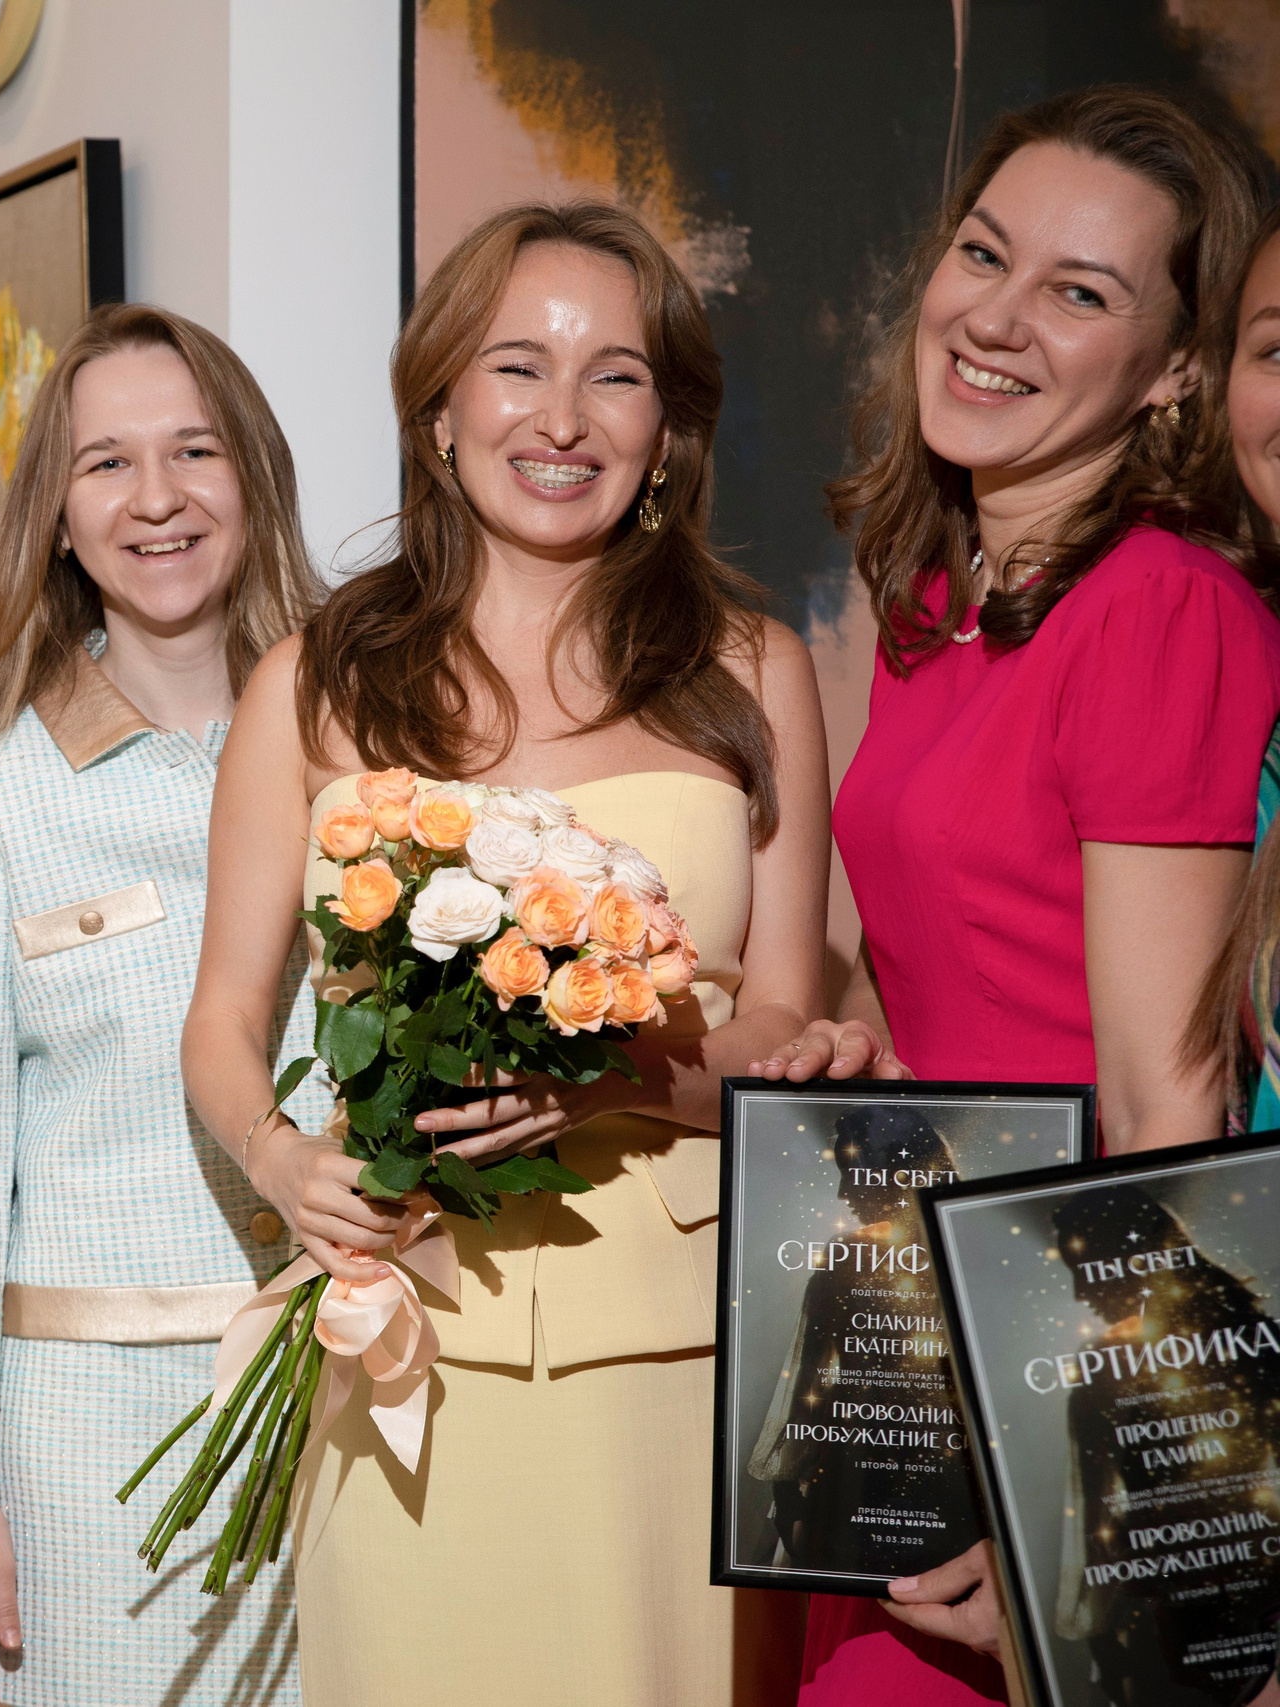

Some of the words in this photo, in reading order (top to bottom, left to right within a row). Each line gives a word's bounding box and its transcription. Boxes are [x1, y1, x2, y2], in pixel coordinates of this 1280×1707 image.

[849, 1168, 887, 1186] ТЫ
[894, 1169, 959, 1187] СВЕТ
[777, 1240, 930, 1274] СЕРТИФ
[1077, 1258, 1124, 1283] ТЫ
[1128, 1244, 1198, 1275] СВЕТ
[817, 1368, 862, 1376] УСПЕШНО
[866, 1370, 904, 1379] ПРОШЛА
[831, 1377, 910, 1388] ТЕОРЕТИЧЕСКУЮ
[914, 1382, 945, 1390] ЧАСТИ
[1115, 1408, 1239, 1447] ПРОЦЕНКО
[786, 1424, 940, 1448] ПРОБУЖДЕНИЕ
[1142, 1439, 1227, 1470] ГАЛИНА
[861, 1462, 899, 1471] ВТОРОЙ
[905, 1464, 936, 1473] ПОТОК
[858, 1507, 938, 1519] ПРЕПОДАВАТЕЛЬ
[851, 1515, 901, 1526] АЙЗЯТОВА
[905, 1519, 946, 1528] МАРЬЯМ
[872, 1534, 923, 1545] 19.03.2025
[1084, 1540, 1258, 1587] ПРОБУЖДЕНИЕ
[1225, 1579, 1260, 1592] ПОТОК
[1242, 1641, 1277, 1654] МАРЬ
